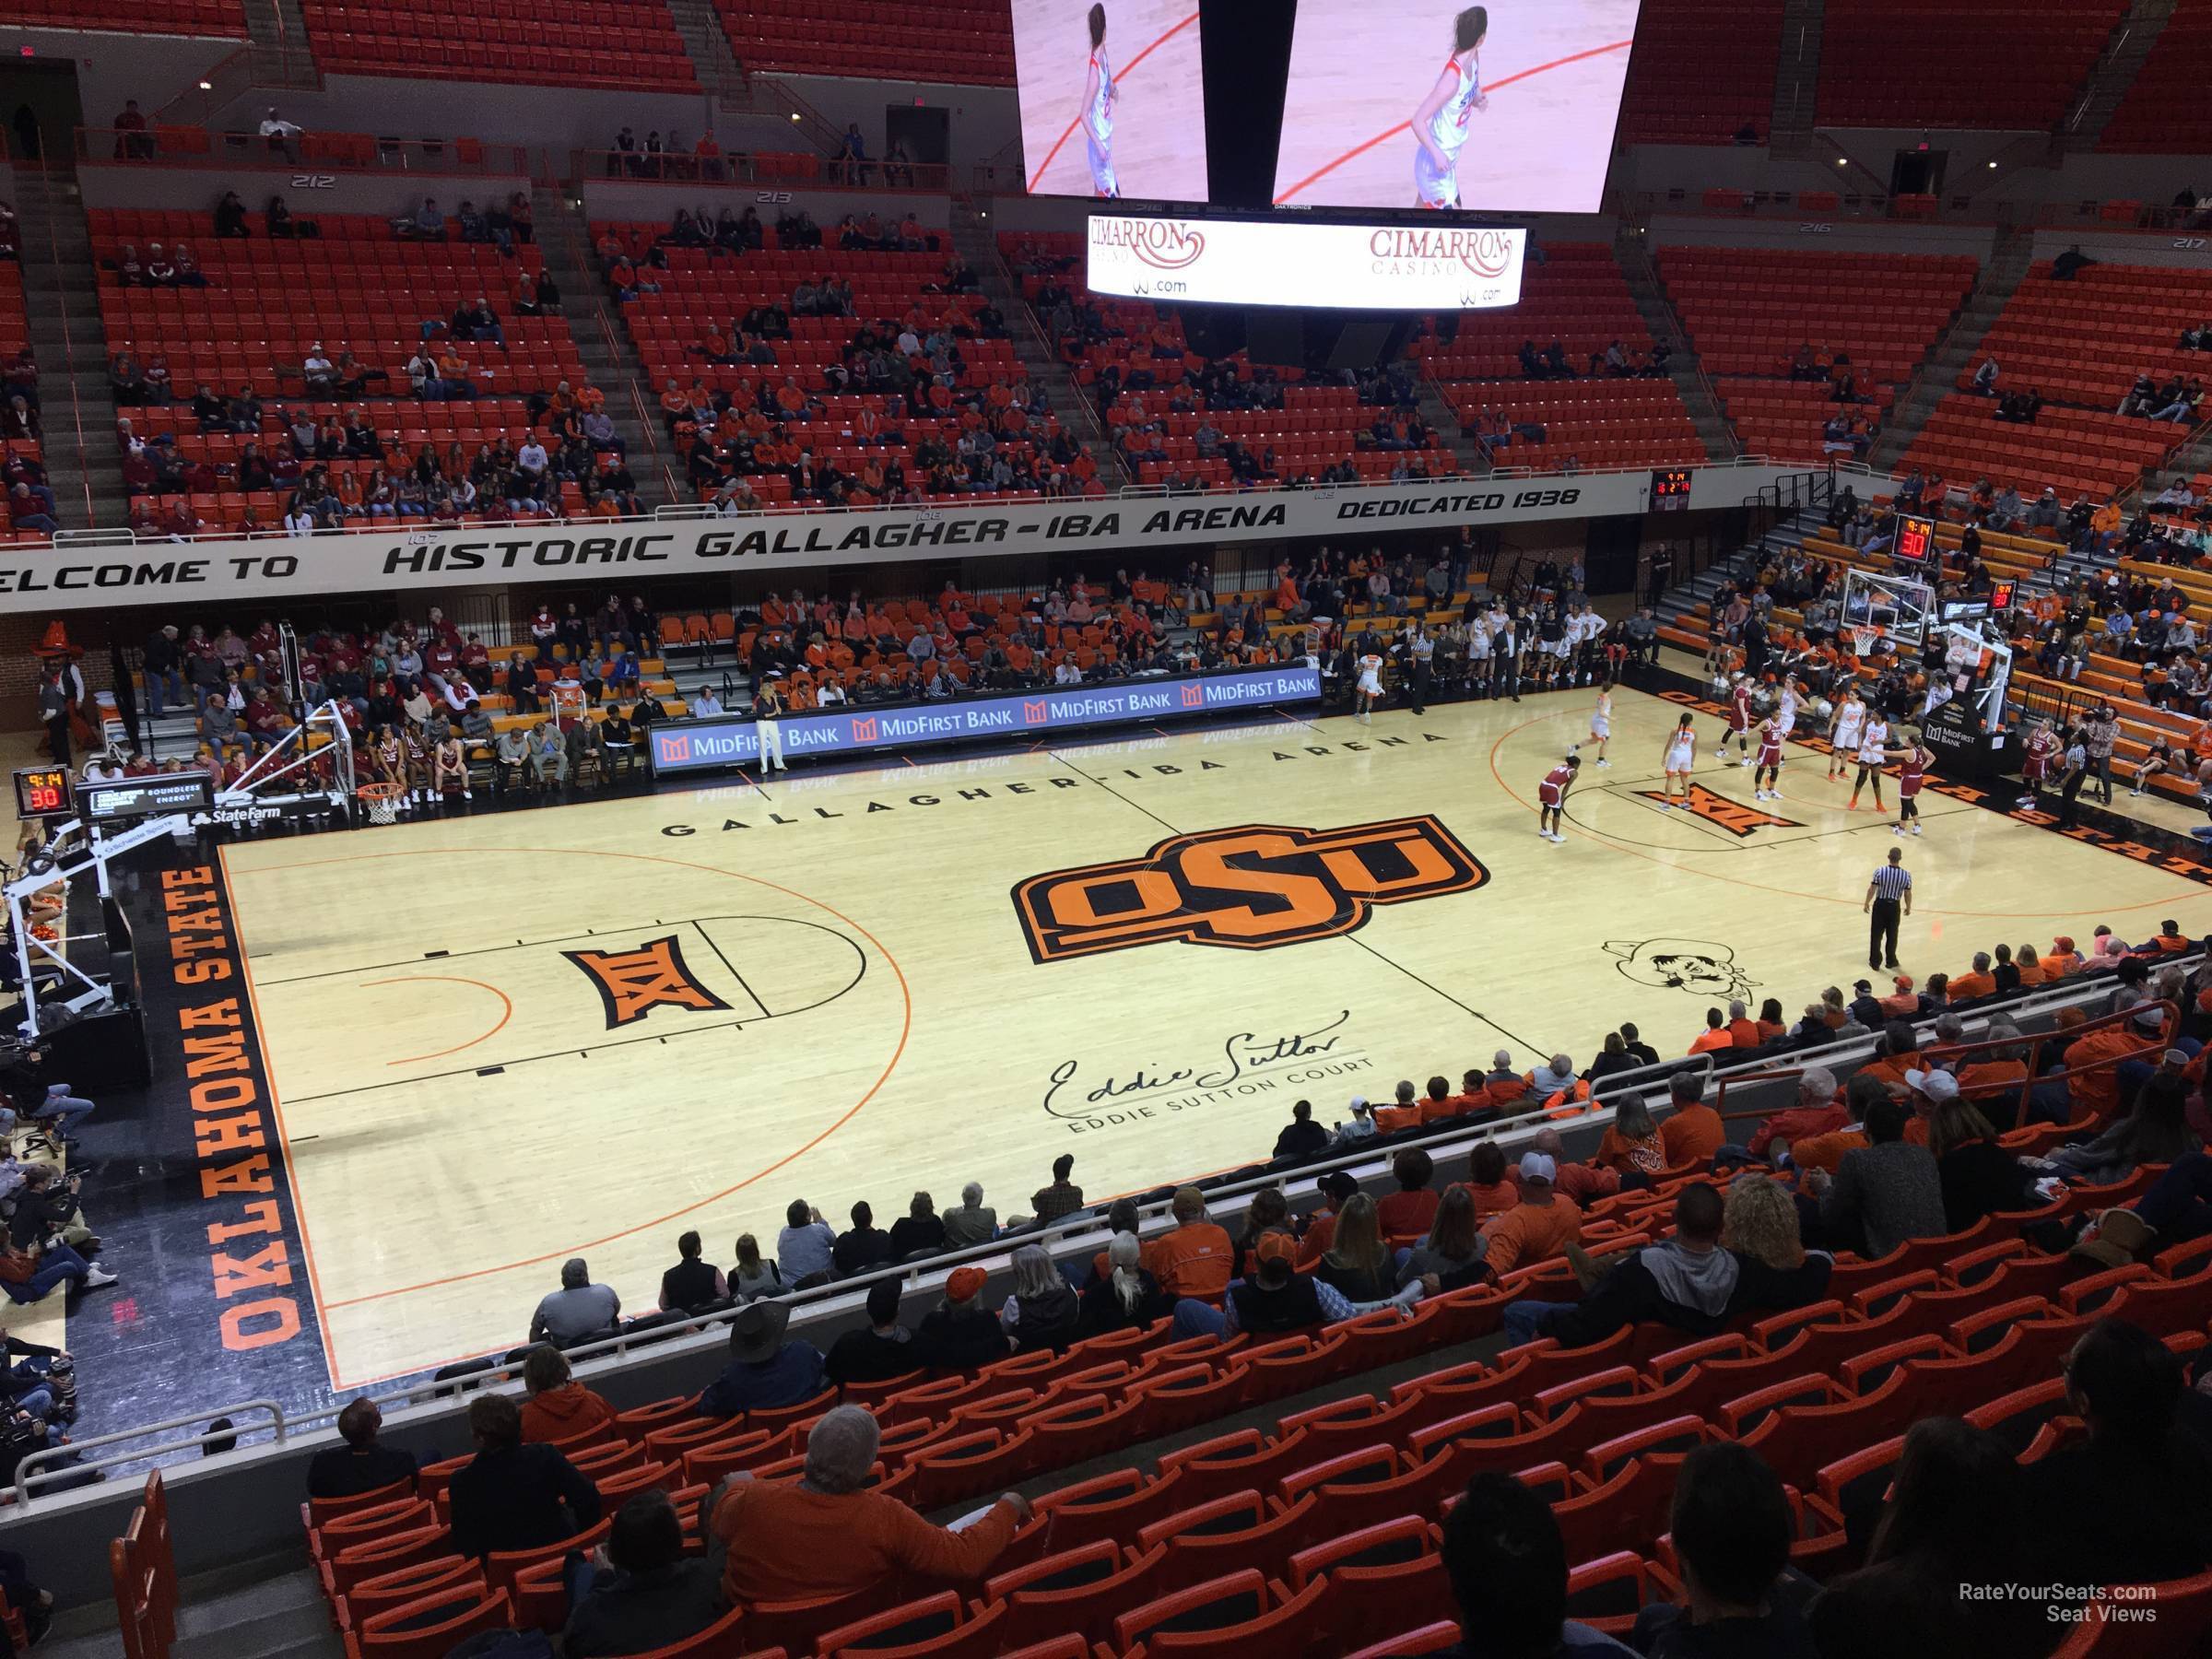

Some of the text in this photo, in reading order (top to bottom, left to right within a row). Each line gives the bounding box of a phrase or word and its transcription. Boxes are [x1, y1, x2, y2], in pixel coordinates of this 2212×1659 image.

[291, 175, 335, 188] 212
[757, 191, 793, 203] 213
[1799, 222, 1833, 232] 216
[1091, 218, 1205, 265] CIMARRON
[2172, 238, 2206, 249] 217
[1370, 229, 1512, 276] CIMARRON
[1371, 261, 1457, 276] CASINO
[229, 556, 299, 581] TO
[382, 535, 674, 574] HISTORIC
[695, 512, 1121, 559] GALLAGHER-IBA
[1141, 503, 1287, 535] ARENA
[1336, 493, 1503, 520] DEDICATED
[1512, 488, 1582, 509] 1938
[1908, 520, 1931, 535] 9:14
[1902, 531, 1925, 556] 30
[1994, 594, 2007, 606] 30
[1277, 677, 1316, 695] BANK
[1129, 692, 1171, 712] BANK
[968, 709, 1013, 728] BANK
[788, 727, 840, 747] BANK
[1941, 736, 1961, 747] BANK
[29, 773, 63, 787] 9:14
[147, 784, 200, 796] BOUNDLESS
[661, 732, 1449, 837] GALLAGHER-IBA ARENA
[31, 788, 58, 809] 30
[1010, 813, 1491, 965] OSU
[161, 865, 233, 985] STATE
[1043, 1009, 1350, 1119] Eddie Sutton
[1066, 1057, 1375, 1134] EDDIE SUTTON COURT
[179, 997, 302, 1352] OKLAHOMA
